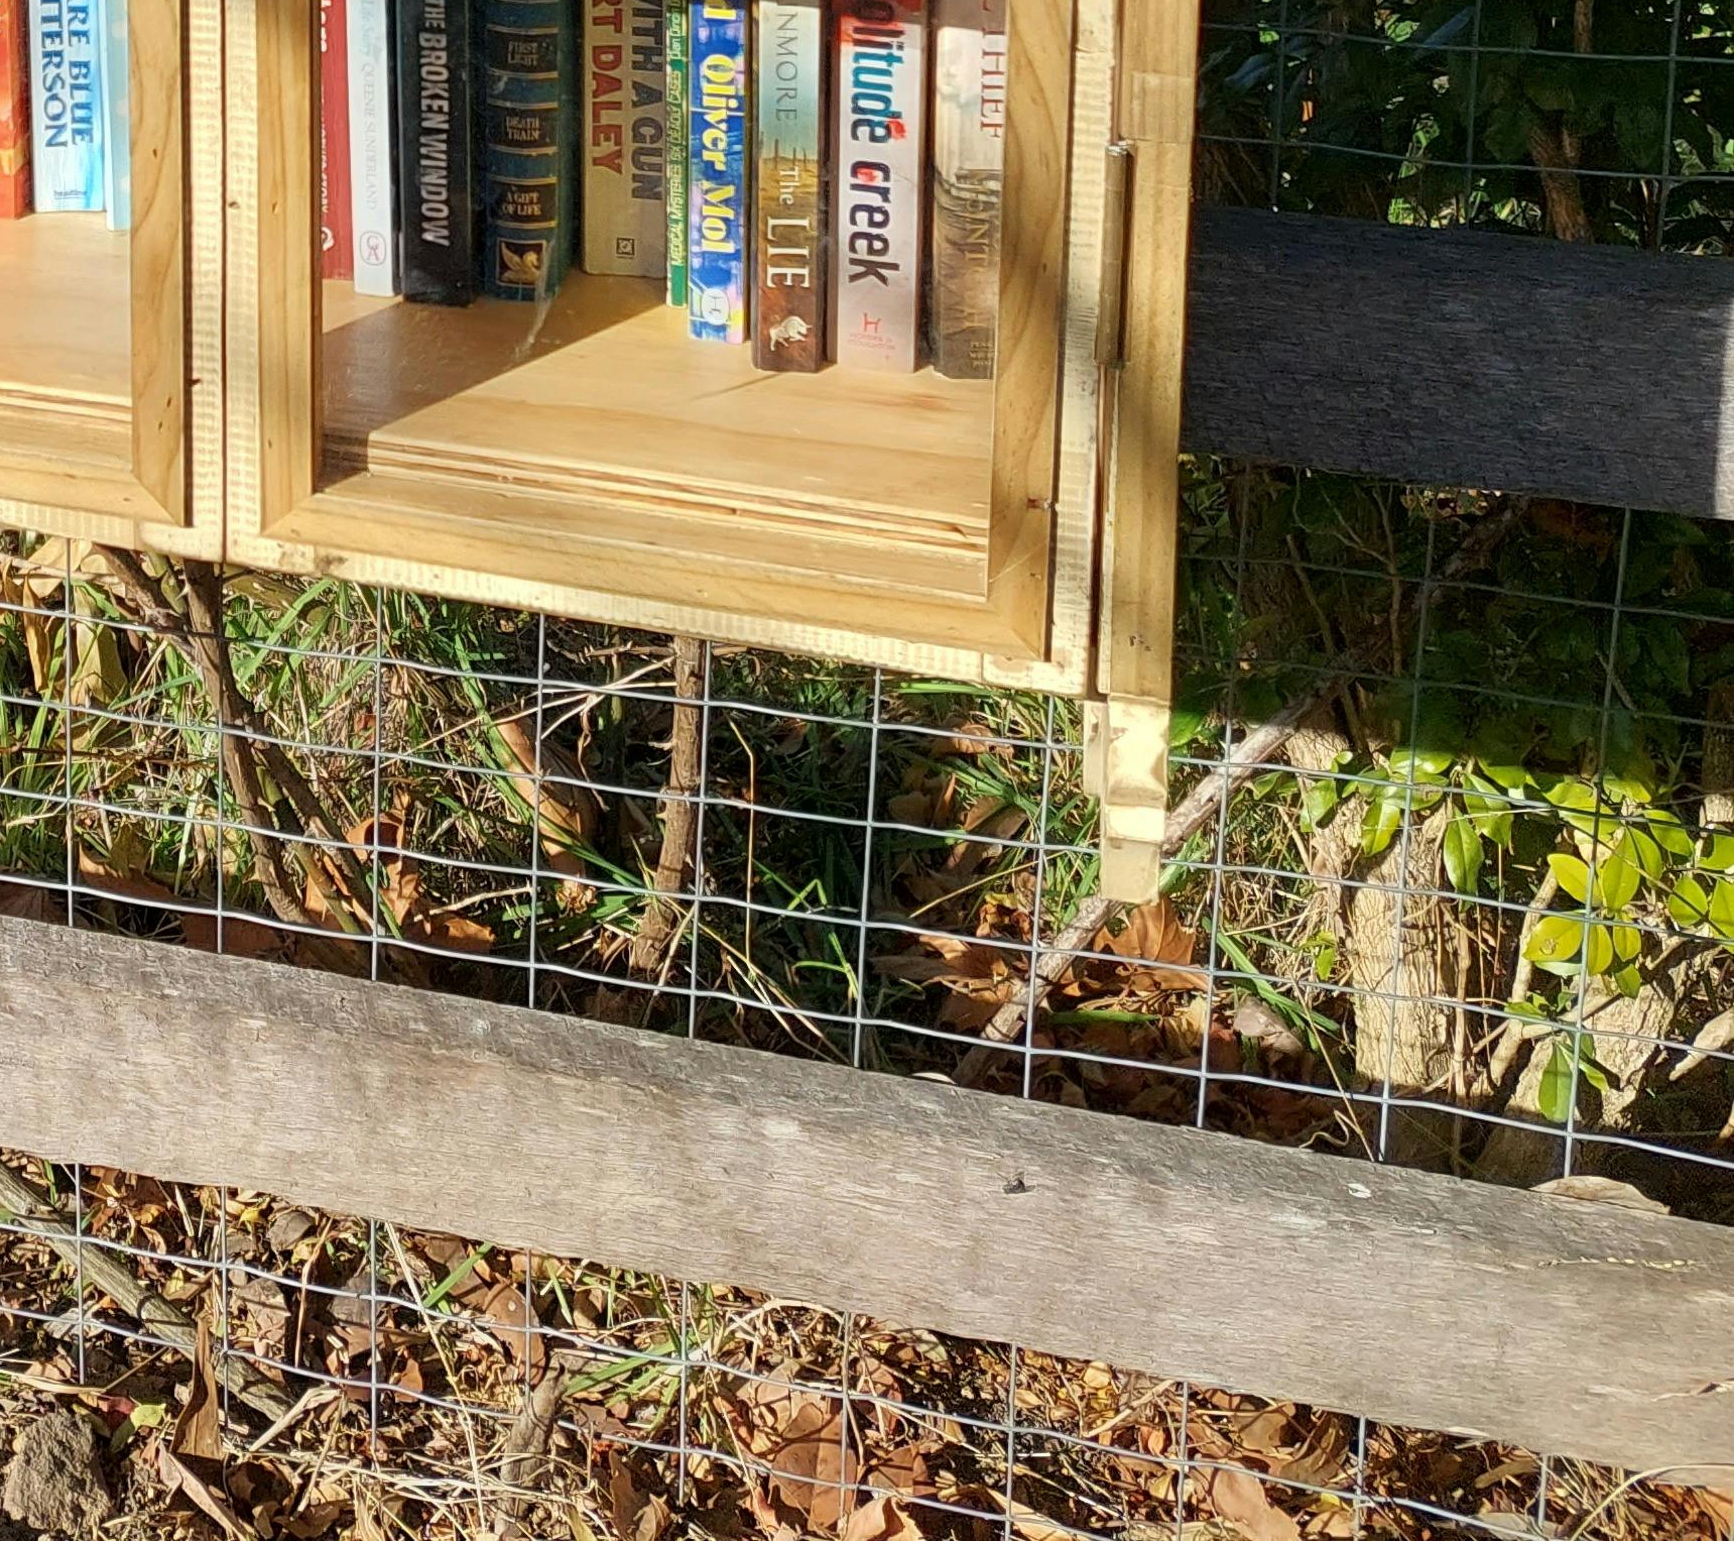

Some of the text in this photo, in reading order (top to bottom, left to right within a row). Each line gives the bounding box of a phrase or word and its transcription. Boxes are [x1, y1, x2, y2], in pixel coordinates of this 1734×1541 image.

[68, 59, 96, 147] BLUE
[417, 30, 449, 127] BROKEN
[590, 43, 624, 175] DALEY
[630, 78, 664, 108] A
[668, 71, 682, 104] CASES
[702, 53, 738, 169] Oliver
[505, 128, 540, 142] TRAIN
[630, 116, 664, 202] GUN
[417, 132, 450, 246] WINDOW
[515, 191, 540, 205] GIFT
[516, 204, 542, 218] LIFE
[702, 184, 737, 256] Mol
[777, 166, 799, 207] The
[668, 221, 684, 267] MEDICAL
[764, 216, 811, 289] LIE
[847, 159, 900, 287] creek
